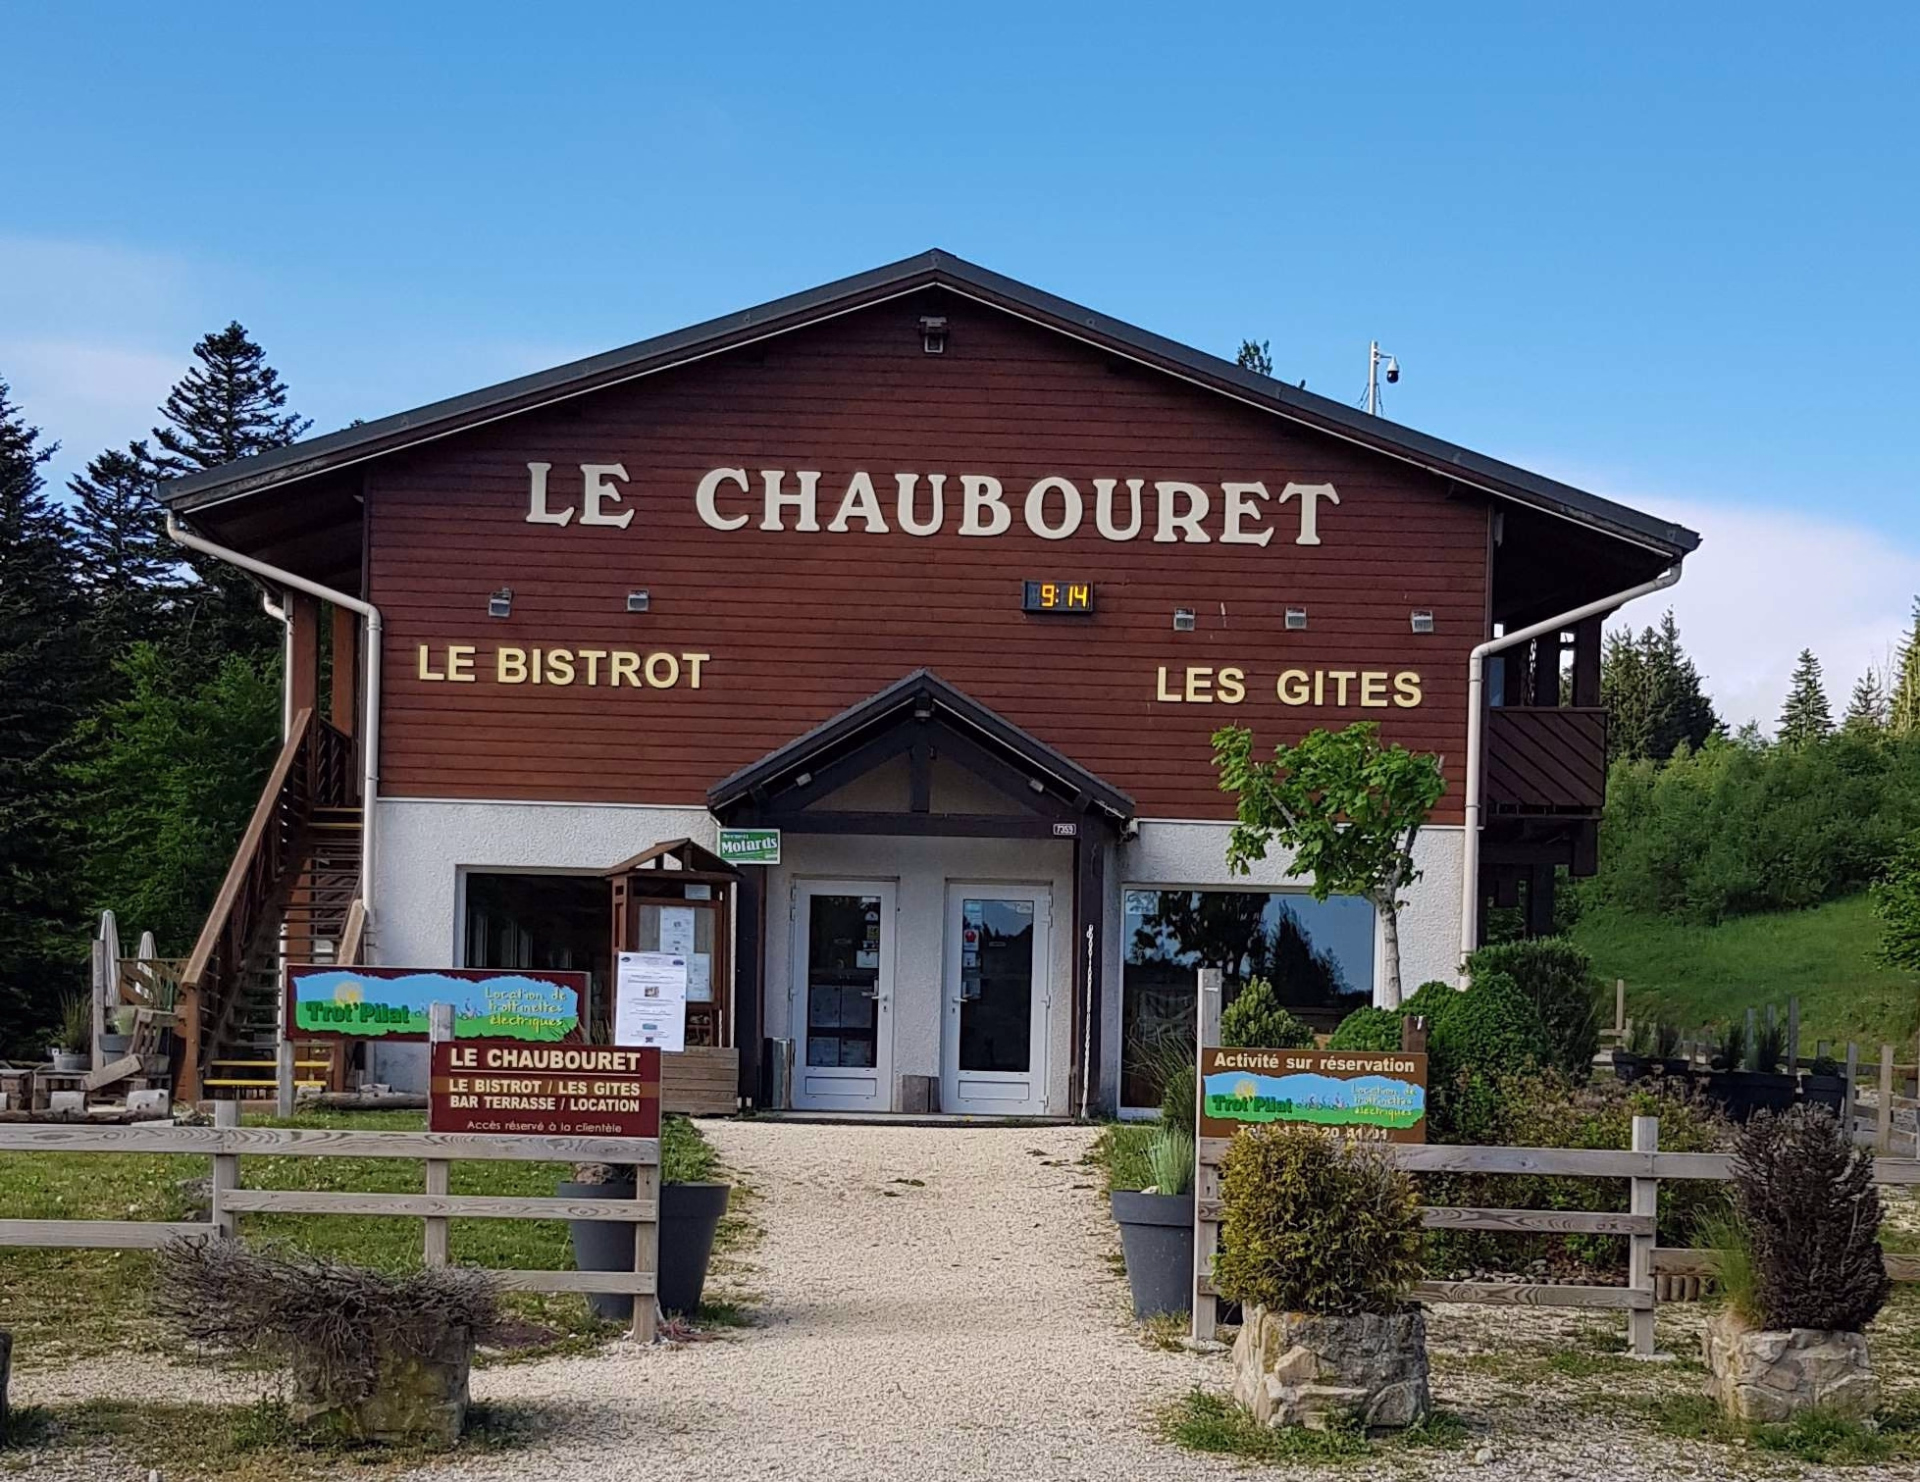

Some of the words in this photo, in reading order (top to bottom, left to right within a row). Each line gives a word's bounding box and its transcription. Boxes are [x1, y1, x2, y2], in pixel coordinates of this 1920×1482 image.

[526, 462, 635, 530] LE
[695, 467, 1341, 548] CHAUBOURET
[419, 645, 476, 682] LE
[498, 647, 710, 689] BISTROT
[1157, 666, 1246, 704] LES
[1276, 669, 1423, 708] GITES
[485, 986, 545, 1000] Location
[551, 987, 568, 1000] de
[305, 1001, 411, 1024] Trot'Pilat
[489, 1013, 565, 1033] électriques
[450, 1048, 478, 1067] LE
[487, 1049, 641, 1071] CHAUBOURET
[1214, 1052, 1279, 1069] Activité
[1286, 1057, 1313, 1070] sur
[1320, 1055, 1415, 1073] réservation
[449, 1079, 468, 1093] LE
[475, 1079, 542, 1094] BISTROT
[558, 1081, 588, 1095] LES
[593, 1082, 640, 1096] GITES
[450, 1095, 478, 1109] BAR
[484, 1096, 556, 1110] TERRASSE
[570, 1099, 640, 1113] LOCATION
[467, 1120, 501, 1130] Accès
[505, 1120, 544, 1131] réservé
[549, 1121, 557, 1131] à
[561, 1121, 571, 1132] la
[575, 1122, 622, 1133] clientèle
[1321, 1126, 1340, 1139] 20
